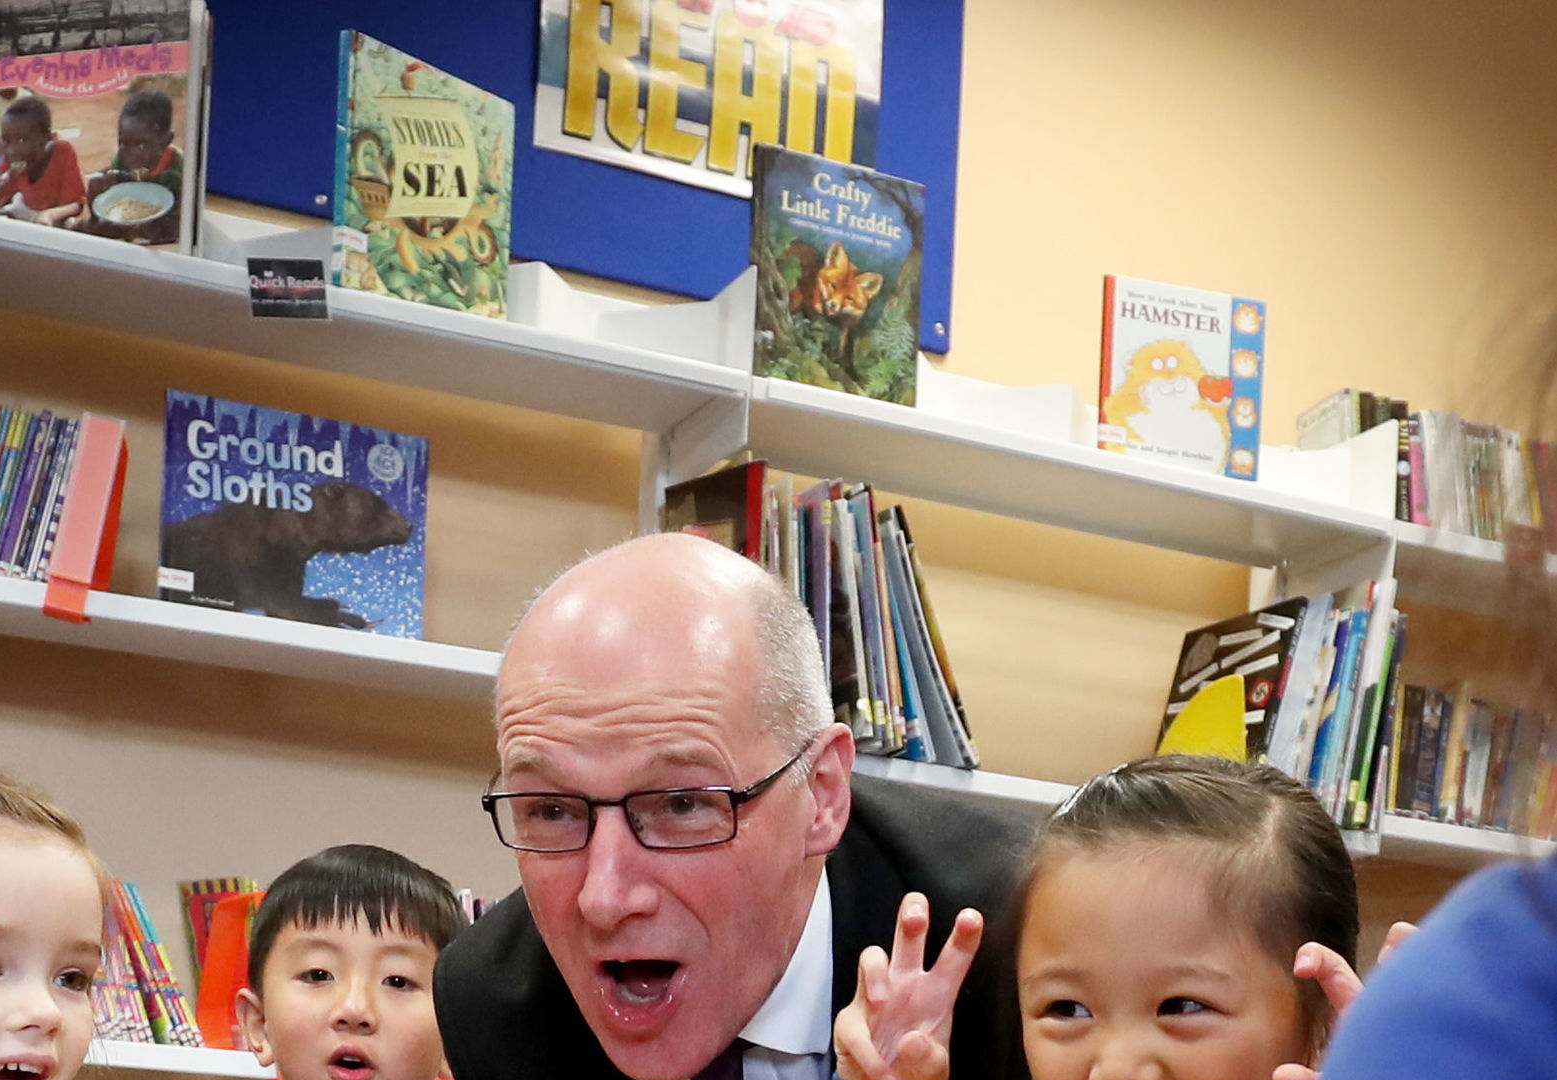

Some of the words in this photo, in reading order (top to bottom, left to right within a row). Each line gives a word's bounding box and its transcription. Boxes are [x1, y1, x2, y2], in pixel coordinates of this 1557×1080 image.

[0, 49, 93, 82] Evening
[561, 0, 857, 179] READ
[391, 117, 466, 149] STORIES
[401, 161, 468, 198] SEA
[812, 172, 873, 212] Crafty
[780, 189, 832, 222] Little
[835, 203, 903, 240] Freddie
[249, 275, 286, 290] Quick
[286, 275, 325, 290] Reads
[1120, 300, 1222, 335] HAMSTER
[186, 418, 344, 479] Ground
[186, 461, 314, 515] Sloths
